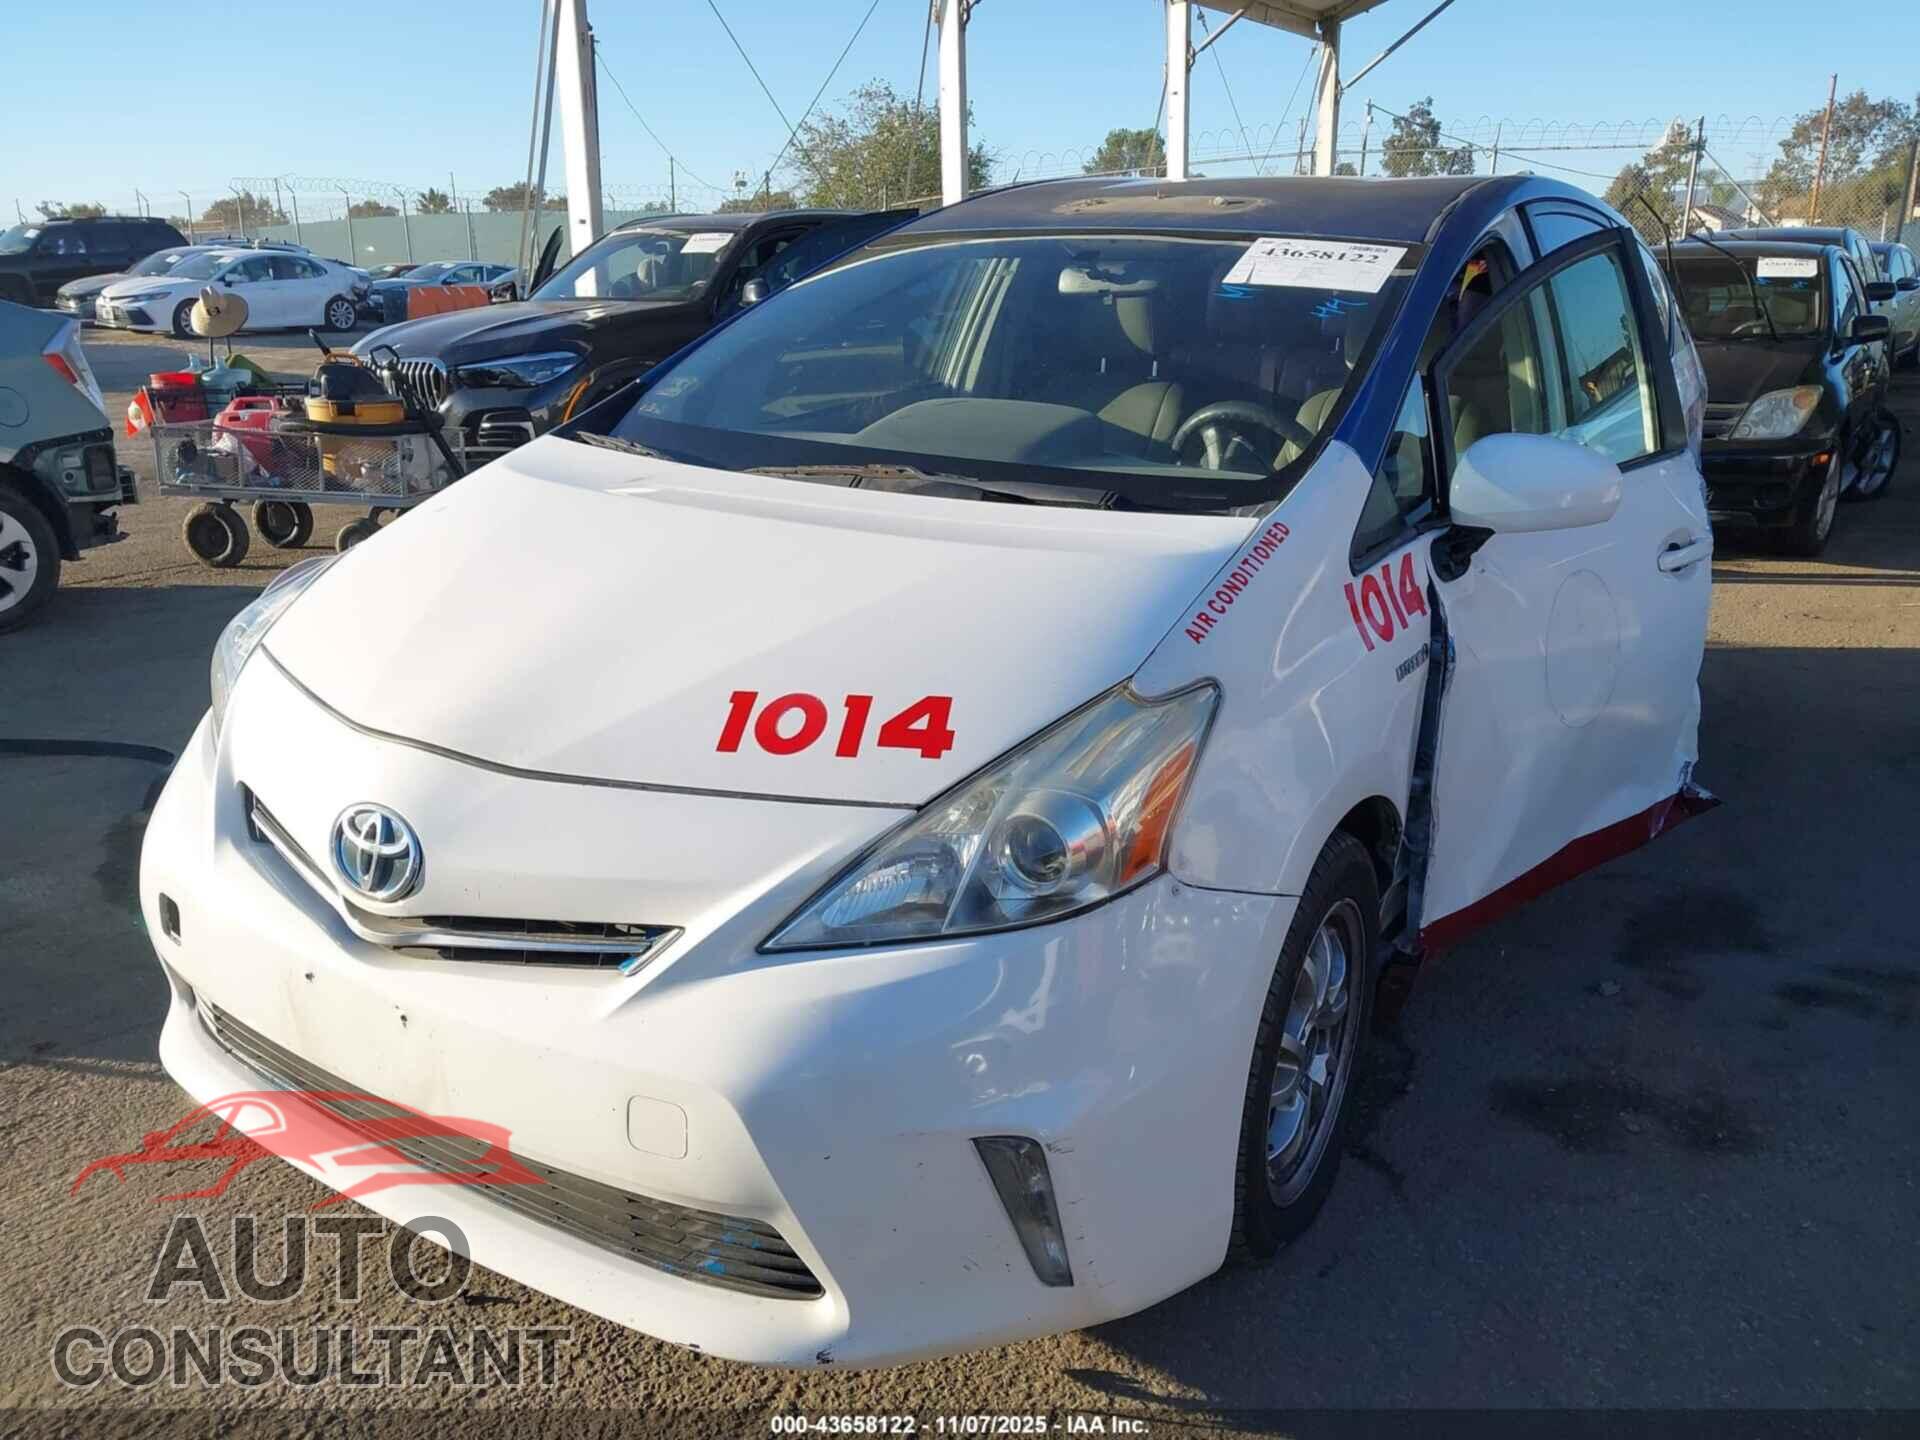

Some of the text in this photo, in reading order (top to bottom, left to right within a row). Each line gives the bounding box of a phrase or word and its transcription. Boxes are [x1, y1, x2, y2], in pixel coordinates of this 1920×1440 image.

[1260, 247, 1380, 264] 43658122
[1184, 521, 1291, 645] AIR CONDITIONED
[1343, 551, 1428, 652] 1014
[715, 690, 956, 760] 1014
